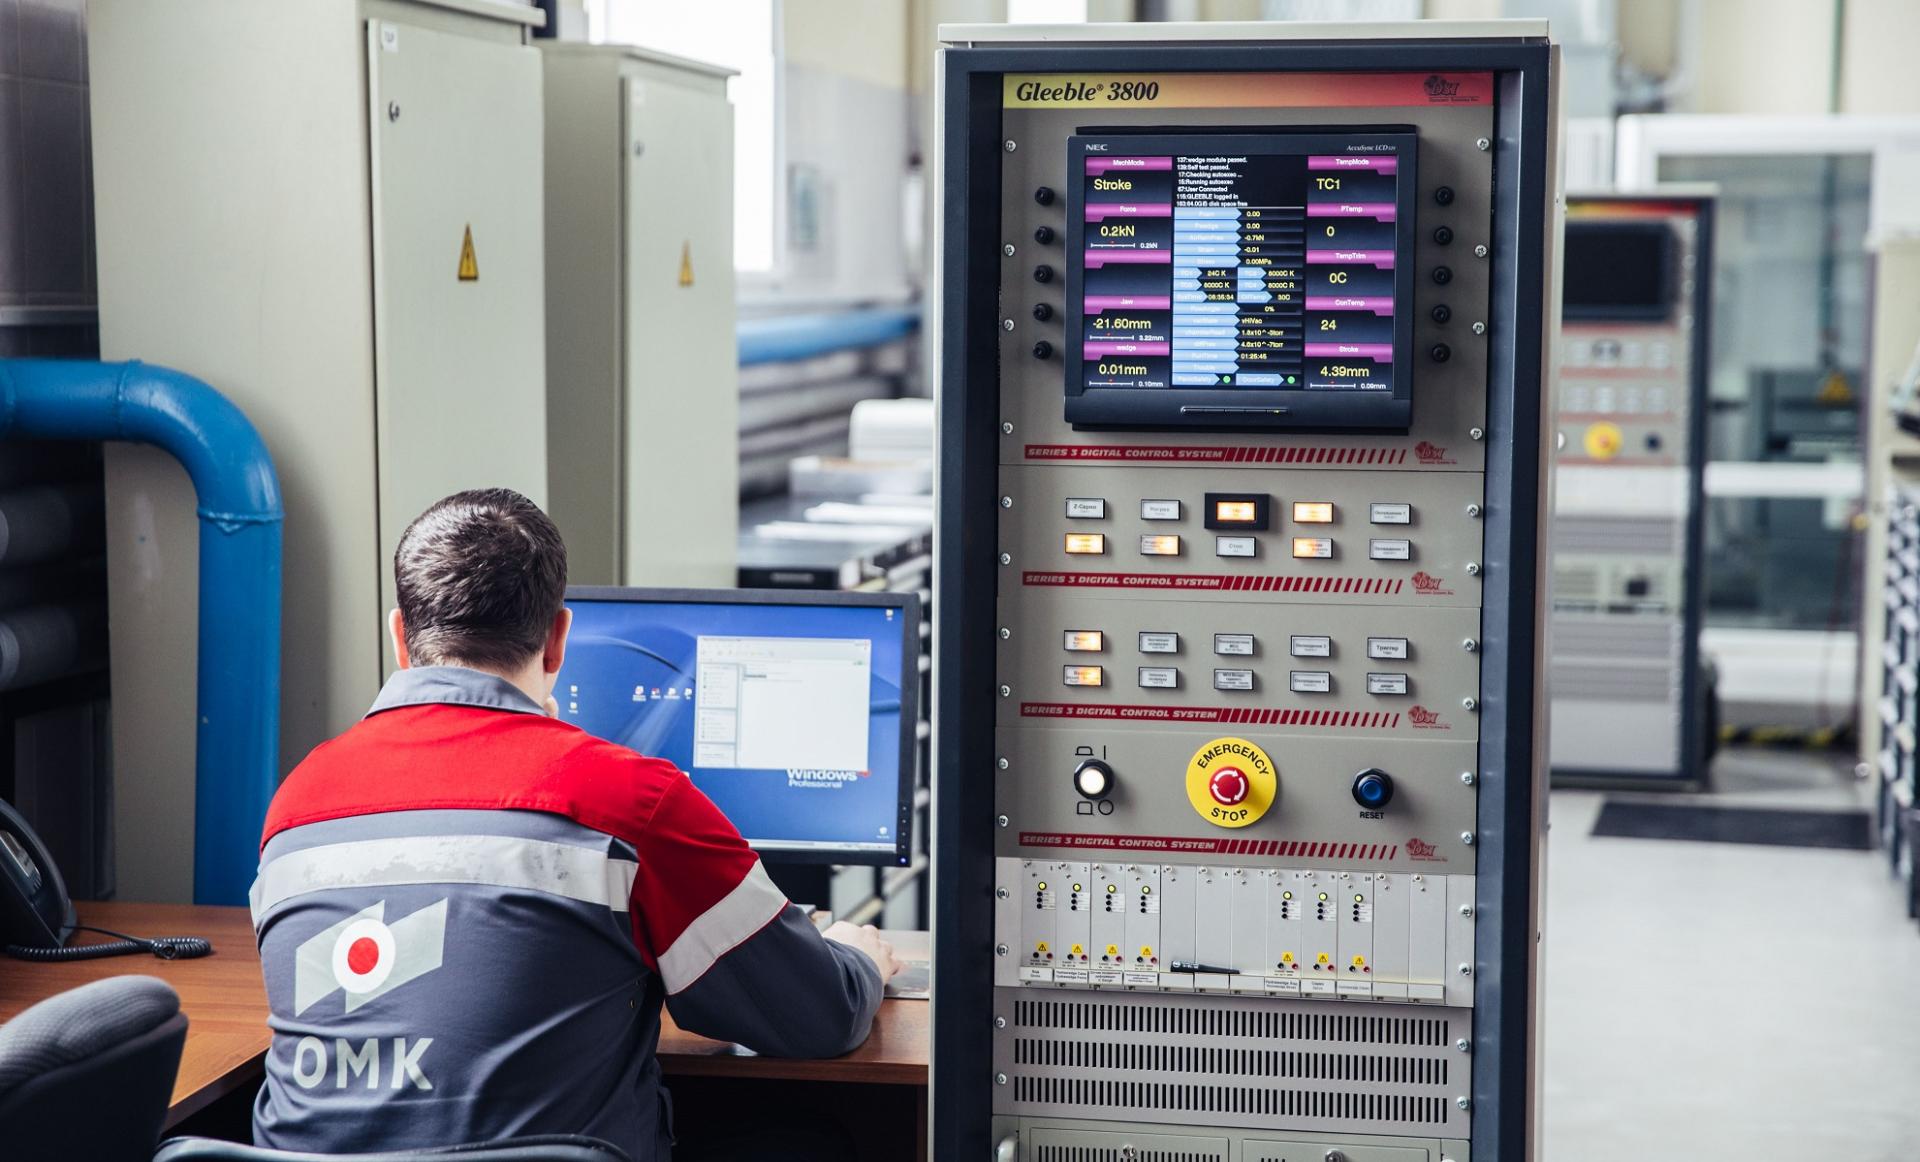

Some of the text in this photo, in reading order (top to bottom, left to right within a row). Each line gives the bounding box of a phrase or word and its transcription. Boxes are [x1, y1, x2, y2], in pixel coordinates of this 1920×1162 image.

[1107, 81, 1159, 101] 3800
[1085, 143, 1108, 151] NEC
[1094, 179, 1132, 190] Stroke
[1316, 178, 1340, 190] TC1
[1100, 225, 1135, 237] 0.2kN
[1326, 226, 1335, 237] 0
[1329, 272, 1347, 283] 0C
[1092, 318, 1152, 329] -21.60mm
[1320, 320, 1337, 330] 24
[1099, 364, 1147, 375] 0.01mm
[1320, 366, 1370, 377] 4.39mm
[1027, 448, 1068, 457] SERIES
[1080, 449, 1122, 457] DIGITAL
[1125, 450, 1174, 458] CONTROL
[1177, 450, 1224, 458] SYSTEM
[1025, 575, 1066, 583] SERIES
[1078, 576, 1120, 584] DIGITAL
[1123, 577, 1172, 585] CONTROL
[1175, 578, 1220, 586] SYSTEM
[1023, 705, 1063, 714] SERIES
[1076, 707, 1117, 716] DIGITAL
[1120, 708, 1170, 717] CONTROL
[1173, 710, 1218, 719] SYSTEM
[1197, 743, 1269, 776] EMERGENCY
[786, 768, 858, 781] Windows
[788, 779, 843, 788] Professional
[1211, 807, 1248, 821] STOP
[1360, 811, 1384, 819] RESET
[1022, 835, 1062, 844] SERIES
[1074, 837, 1115, 846] DIGITAL
[1118, 838, 1168, 848] CONTROL
[1170, 841, 1216, 850] SYSTEM
[292, 1035, 434, 1090] OMK
